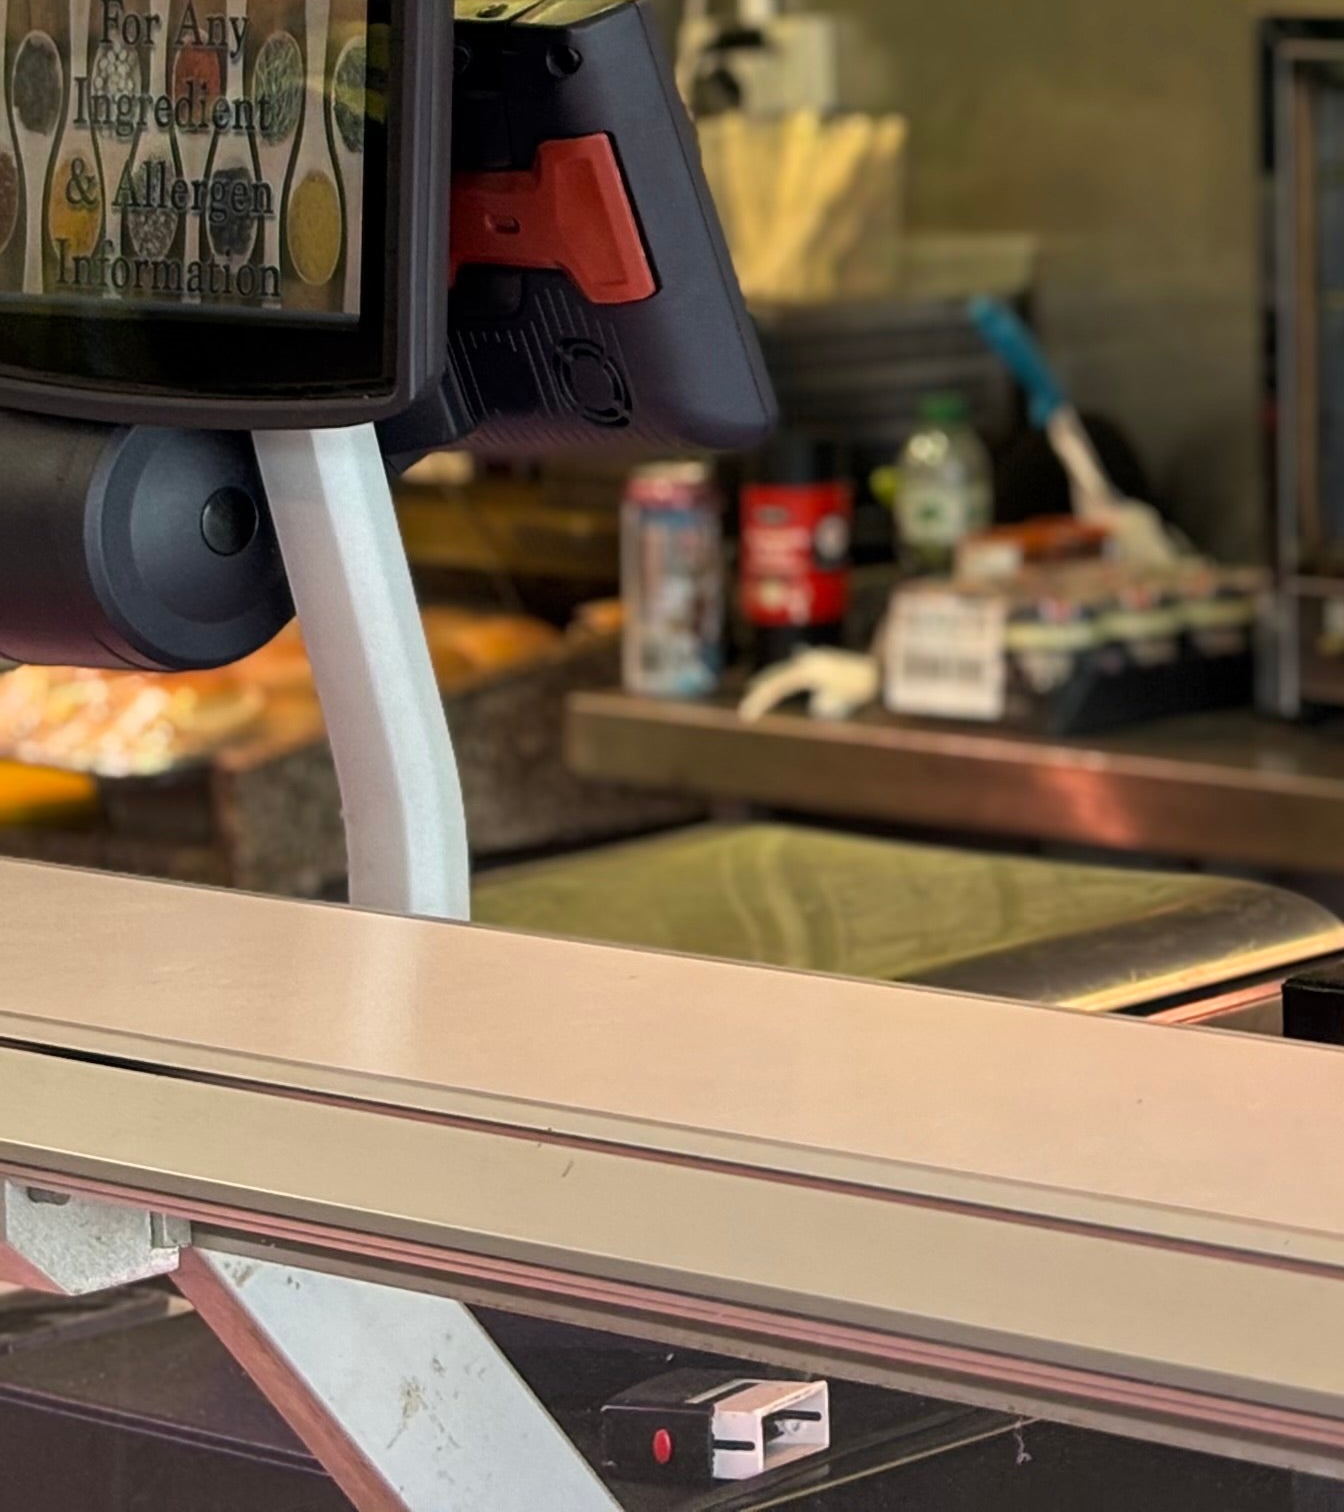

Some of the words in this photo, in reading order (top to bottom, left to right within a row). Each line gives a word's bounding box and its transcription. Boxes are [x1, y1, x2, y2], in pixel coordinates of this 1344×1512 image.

[174, 0, 249, 58] Any
[73, 76, 272, 136] Ingredient
[65, 157, 97, 205] &
[112, 159, 274, 223] Allergen
[56, 238, 281, 297] Information
